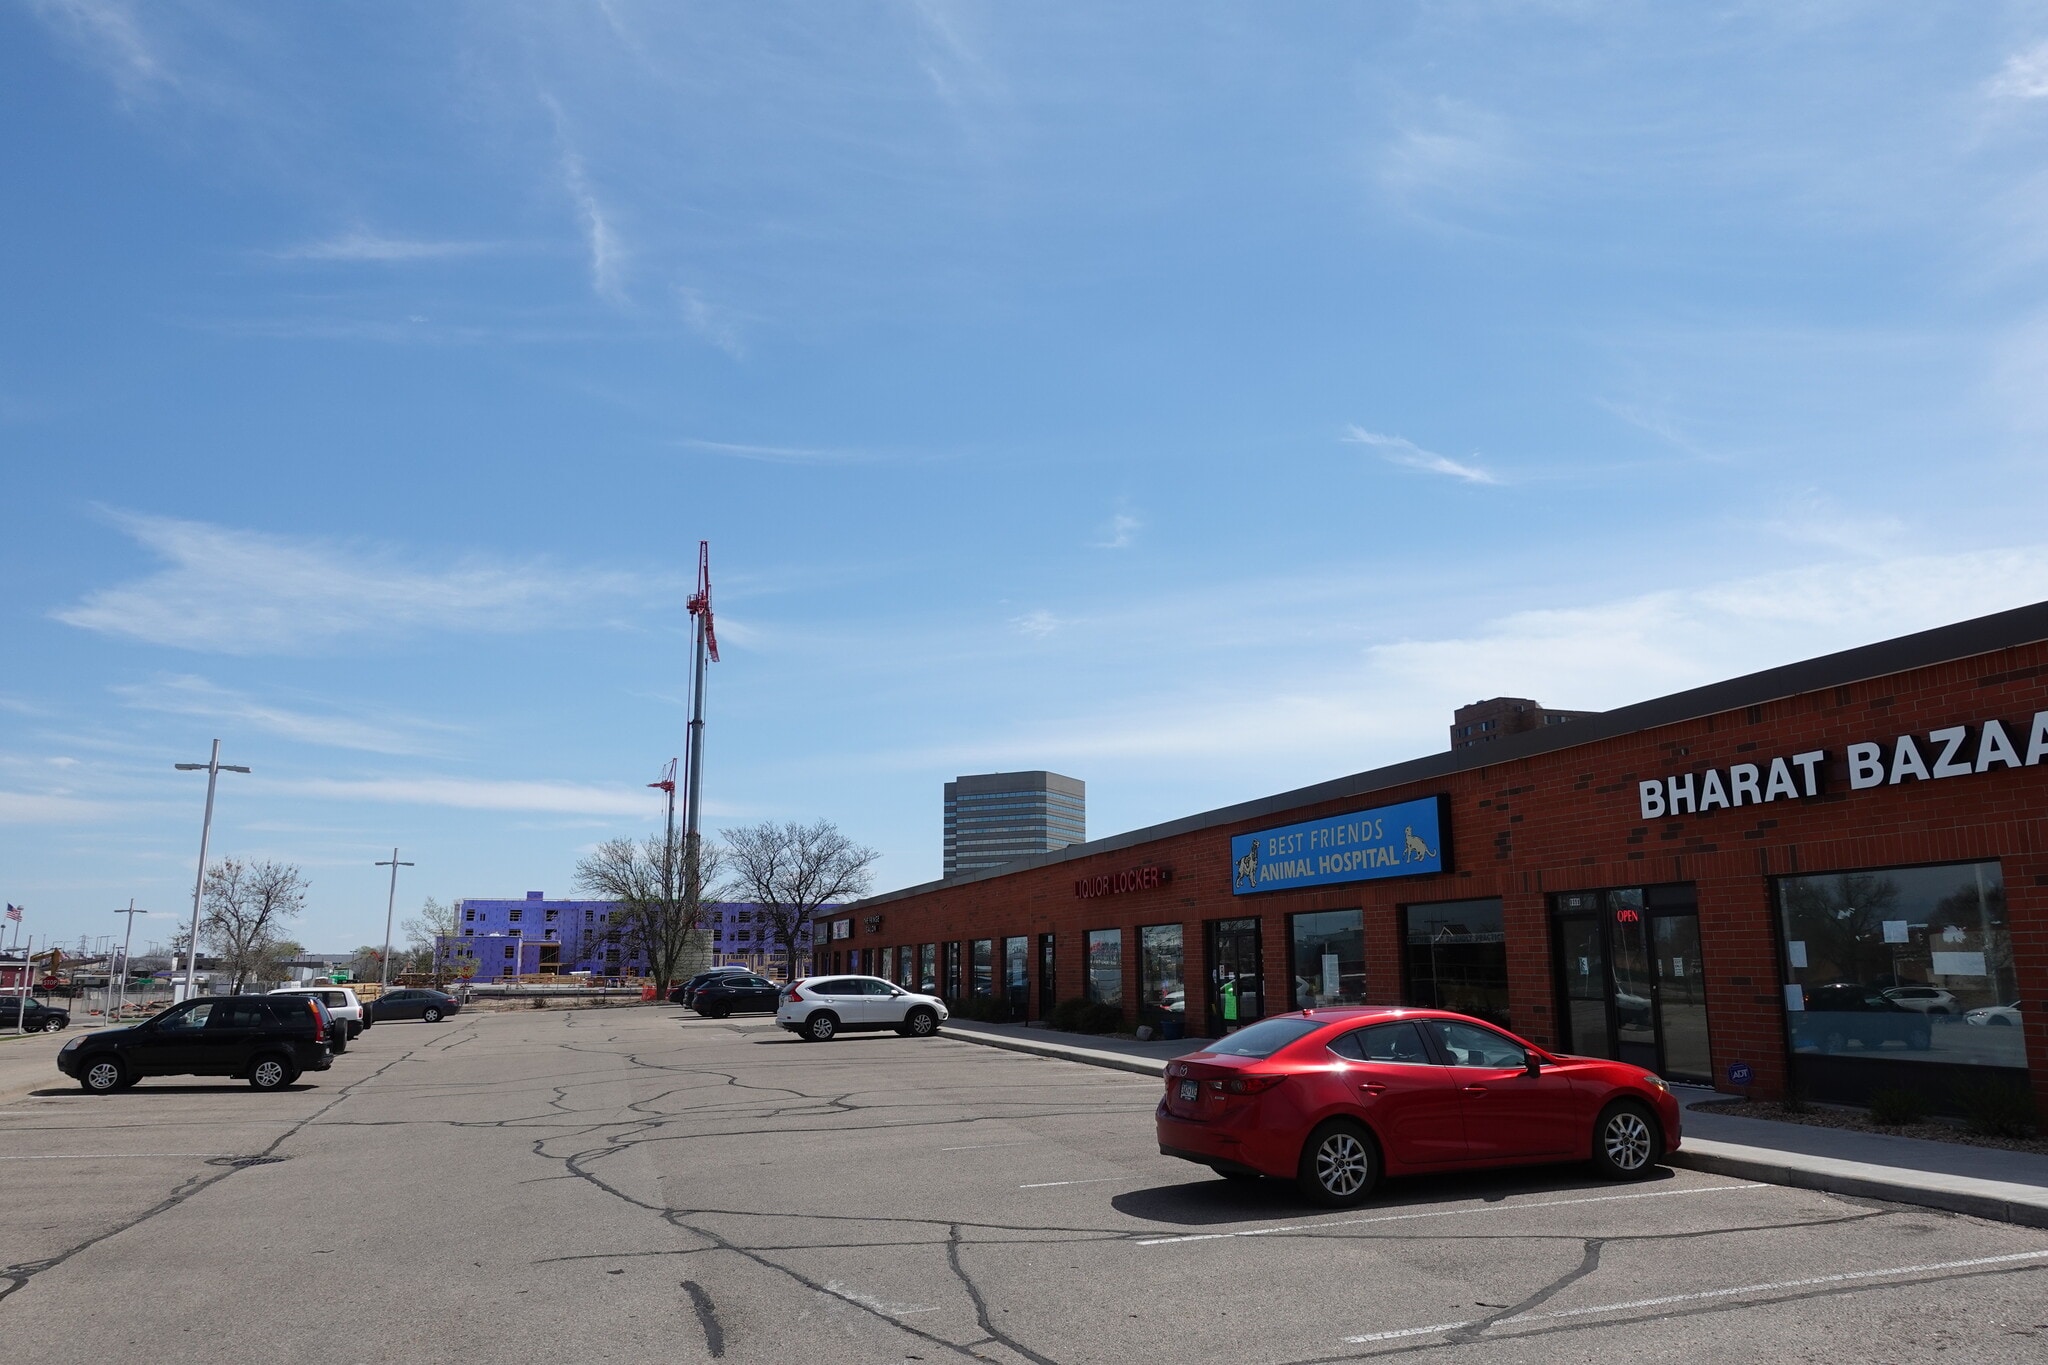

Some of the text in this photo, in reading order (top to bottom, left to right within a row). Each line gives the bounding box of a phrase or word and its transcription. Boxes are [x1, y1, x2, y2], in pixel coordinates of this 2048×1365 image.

[1639, 750, 1825, 820] BHARAT
[1269, 818, 1383, 857] BEST FRIENDS
[1259, 845, 1400, 882] ANIMAL HOSPITAL
[1074, 867, 1159, 899] LIQUOR LOCKER
[1616, 909, 1639, 923] OPEN
[1732, 1068, 1748, 1080] ADT
